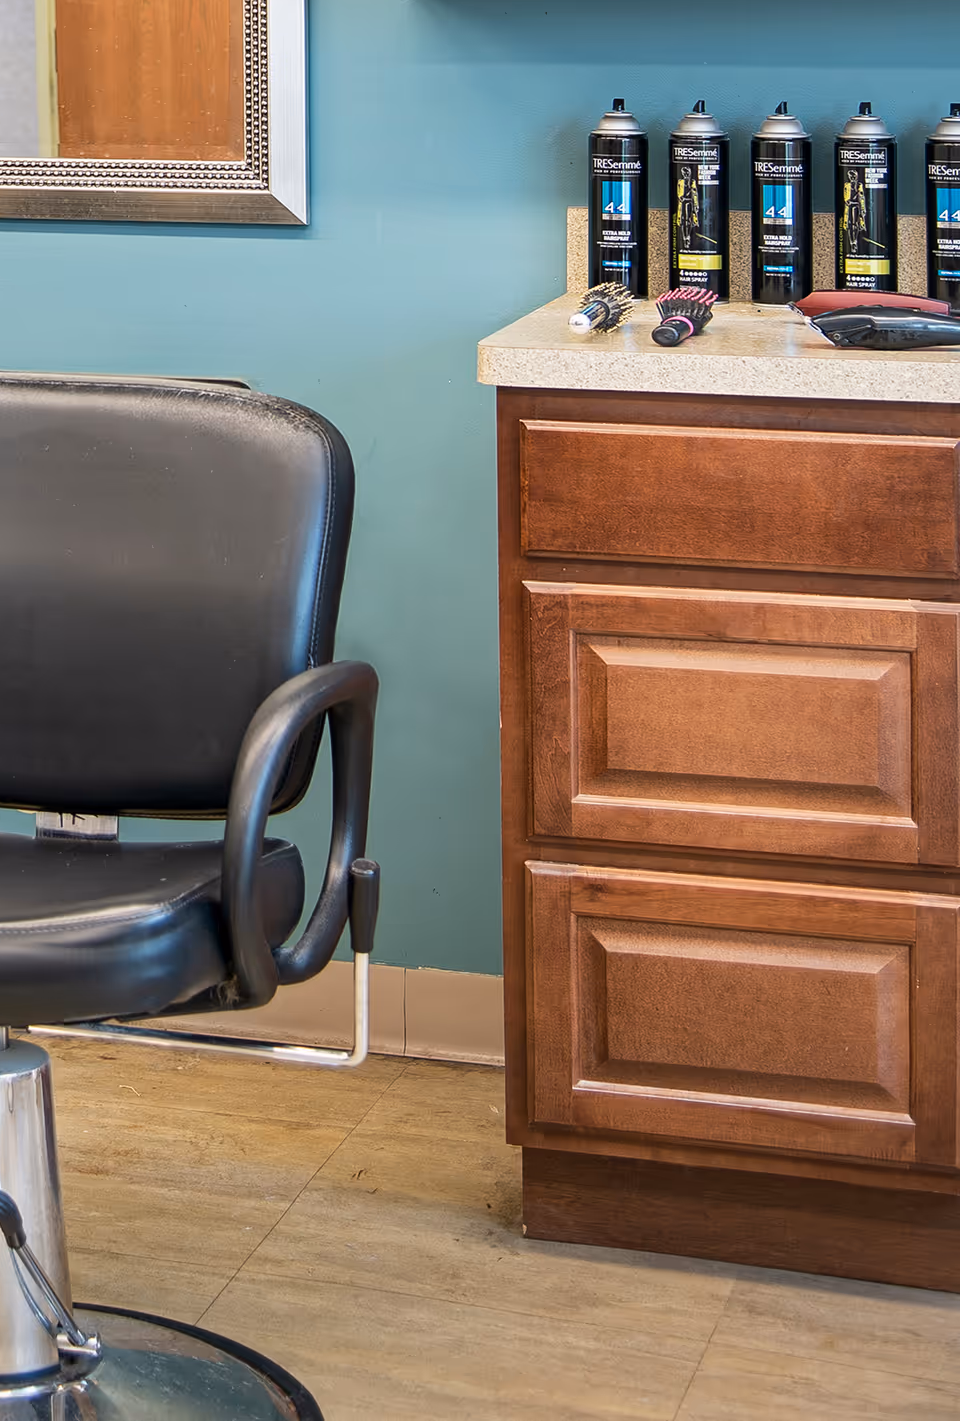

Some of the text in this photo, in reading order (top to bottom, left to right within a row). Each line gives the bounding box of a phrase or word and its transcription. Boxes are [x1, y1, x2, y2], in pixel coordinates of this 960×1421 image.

[673, 147, 718, 157] TRESemmé
[840, 150, 885, 160] TRESemmé
[592, 157, 641, 170] TRESemmé
[754, 161, 803, 173] TRESemmé
